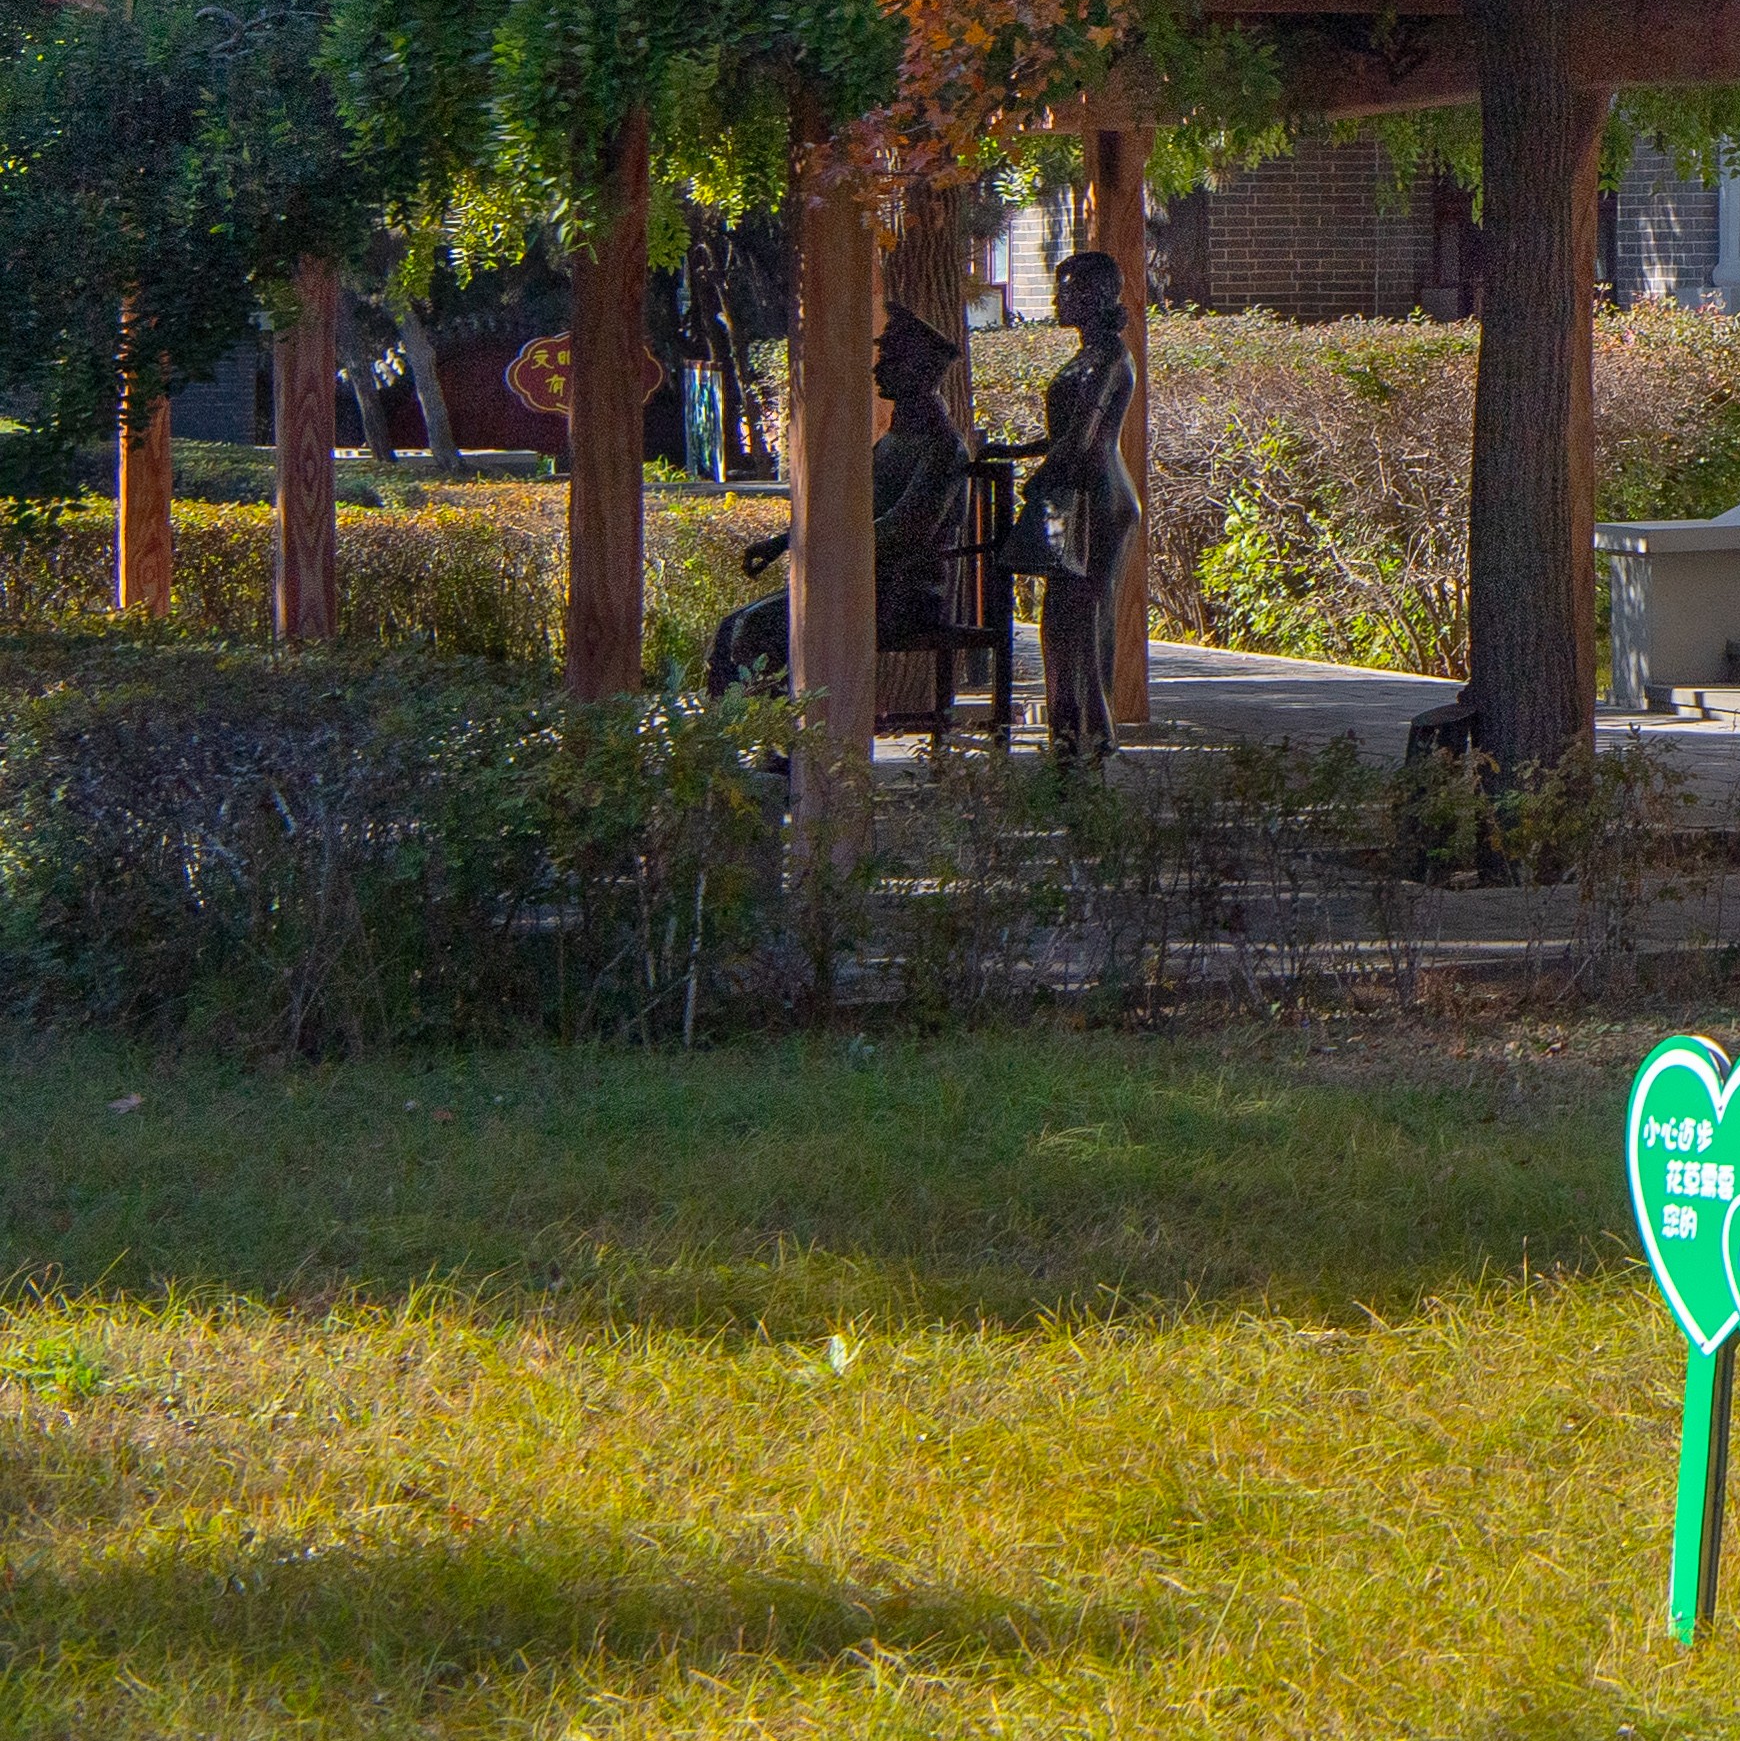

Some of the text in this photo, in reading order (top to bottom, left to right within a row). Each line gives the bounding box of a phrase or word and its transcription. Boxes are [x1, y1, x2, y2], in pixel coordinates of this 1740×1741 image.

[1643, 1115, 1714, 1153] 小心迈步
[1665, 1159, 1735, 1201] 花草需要
[1662, 1203, 1698, 1240] 您的
